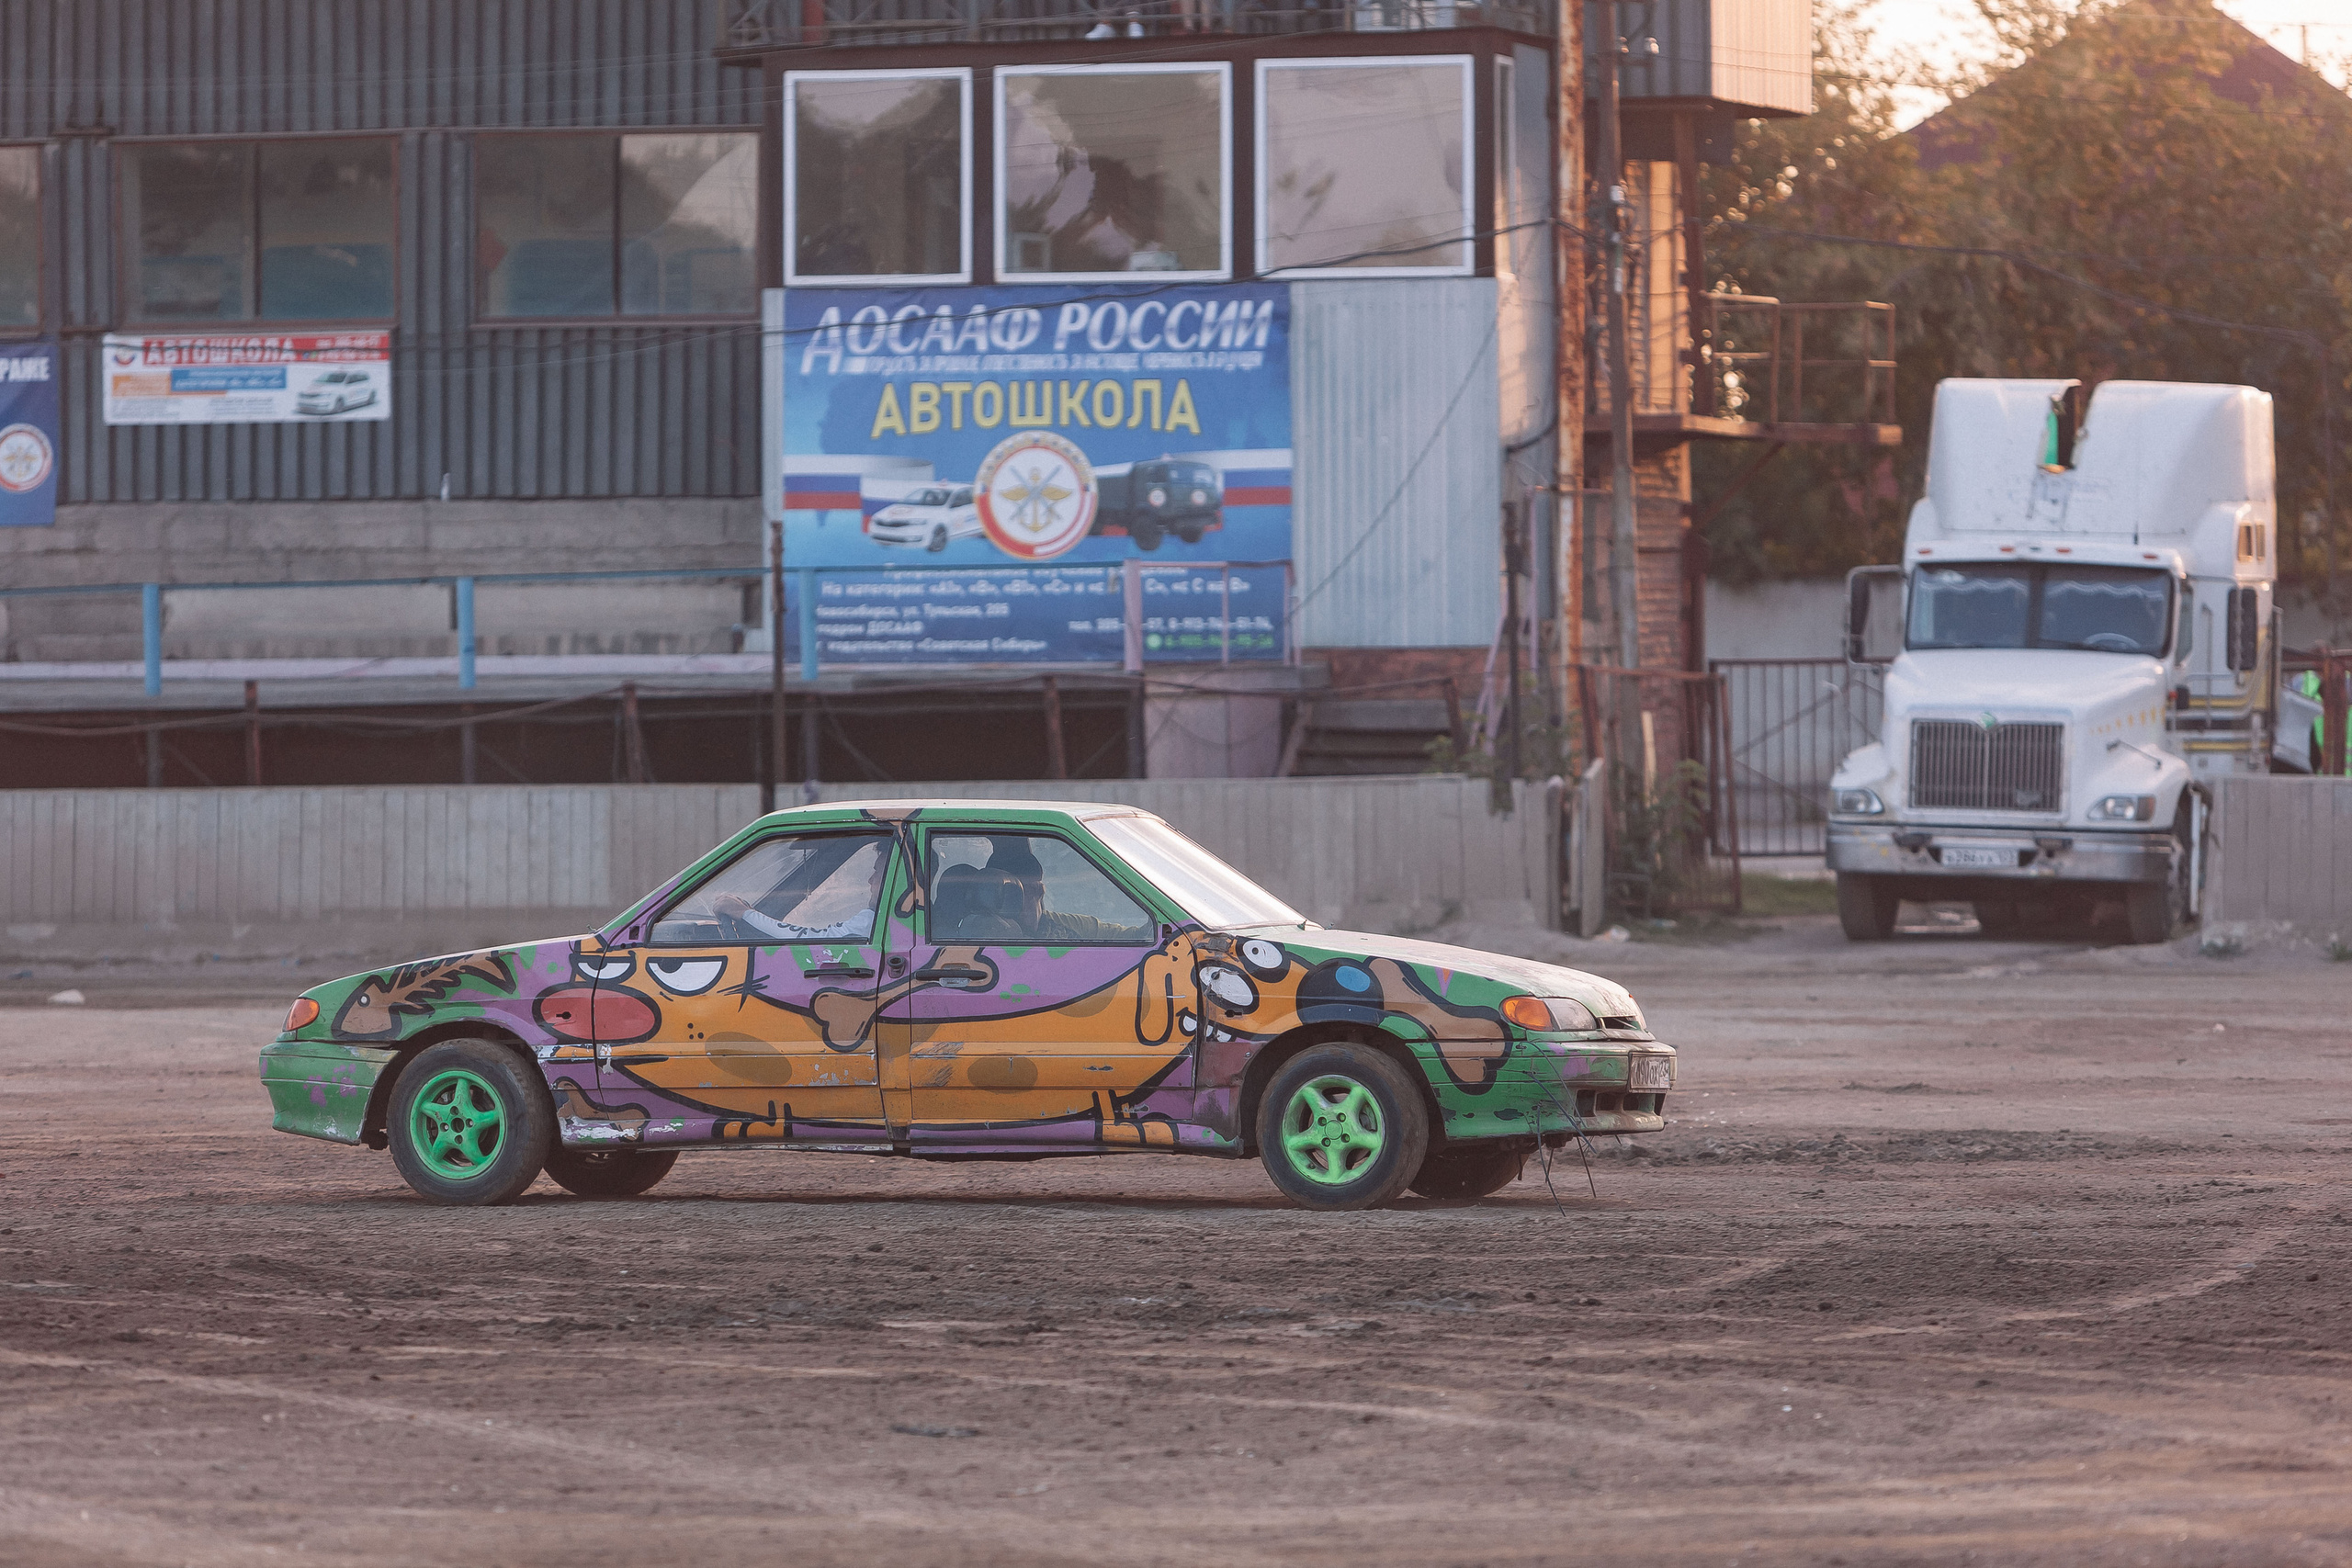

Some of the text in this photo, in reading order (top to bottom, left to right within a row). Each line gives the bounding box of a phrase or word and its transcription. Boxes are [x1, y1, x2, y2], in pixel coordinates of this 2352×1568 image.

[146, 336, 297, 365] АВТОШКОЛА
[800, 299, 1276, 375] ДОСААФ РОССИИ
[870, 378, 1202, 438] АВТОШКОЛА
